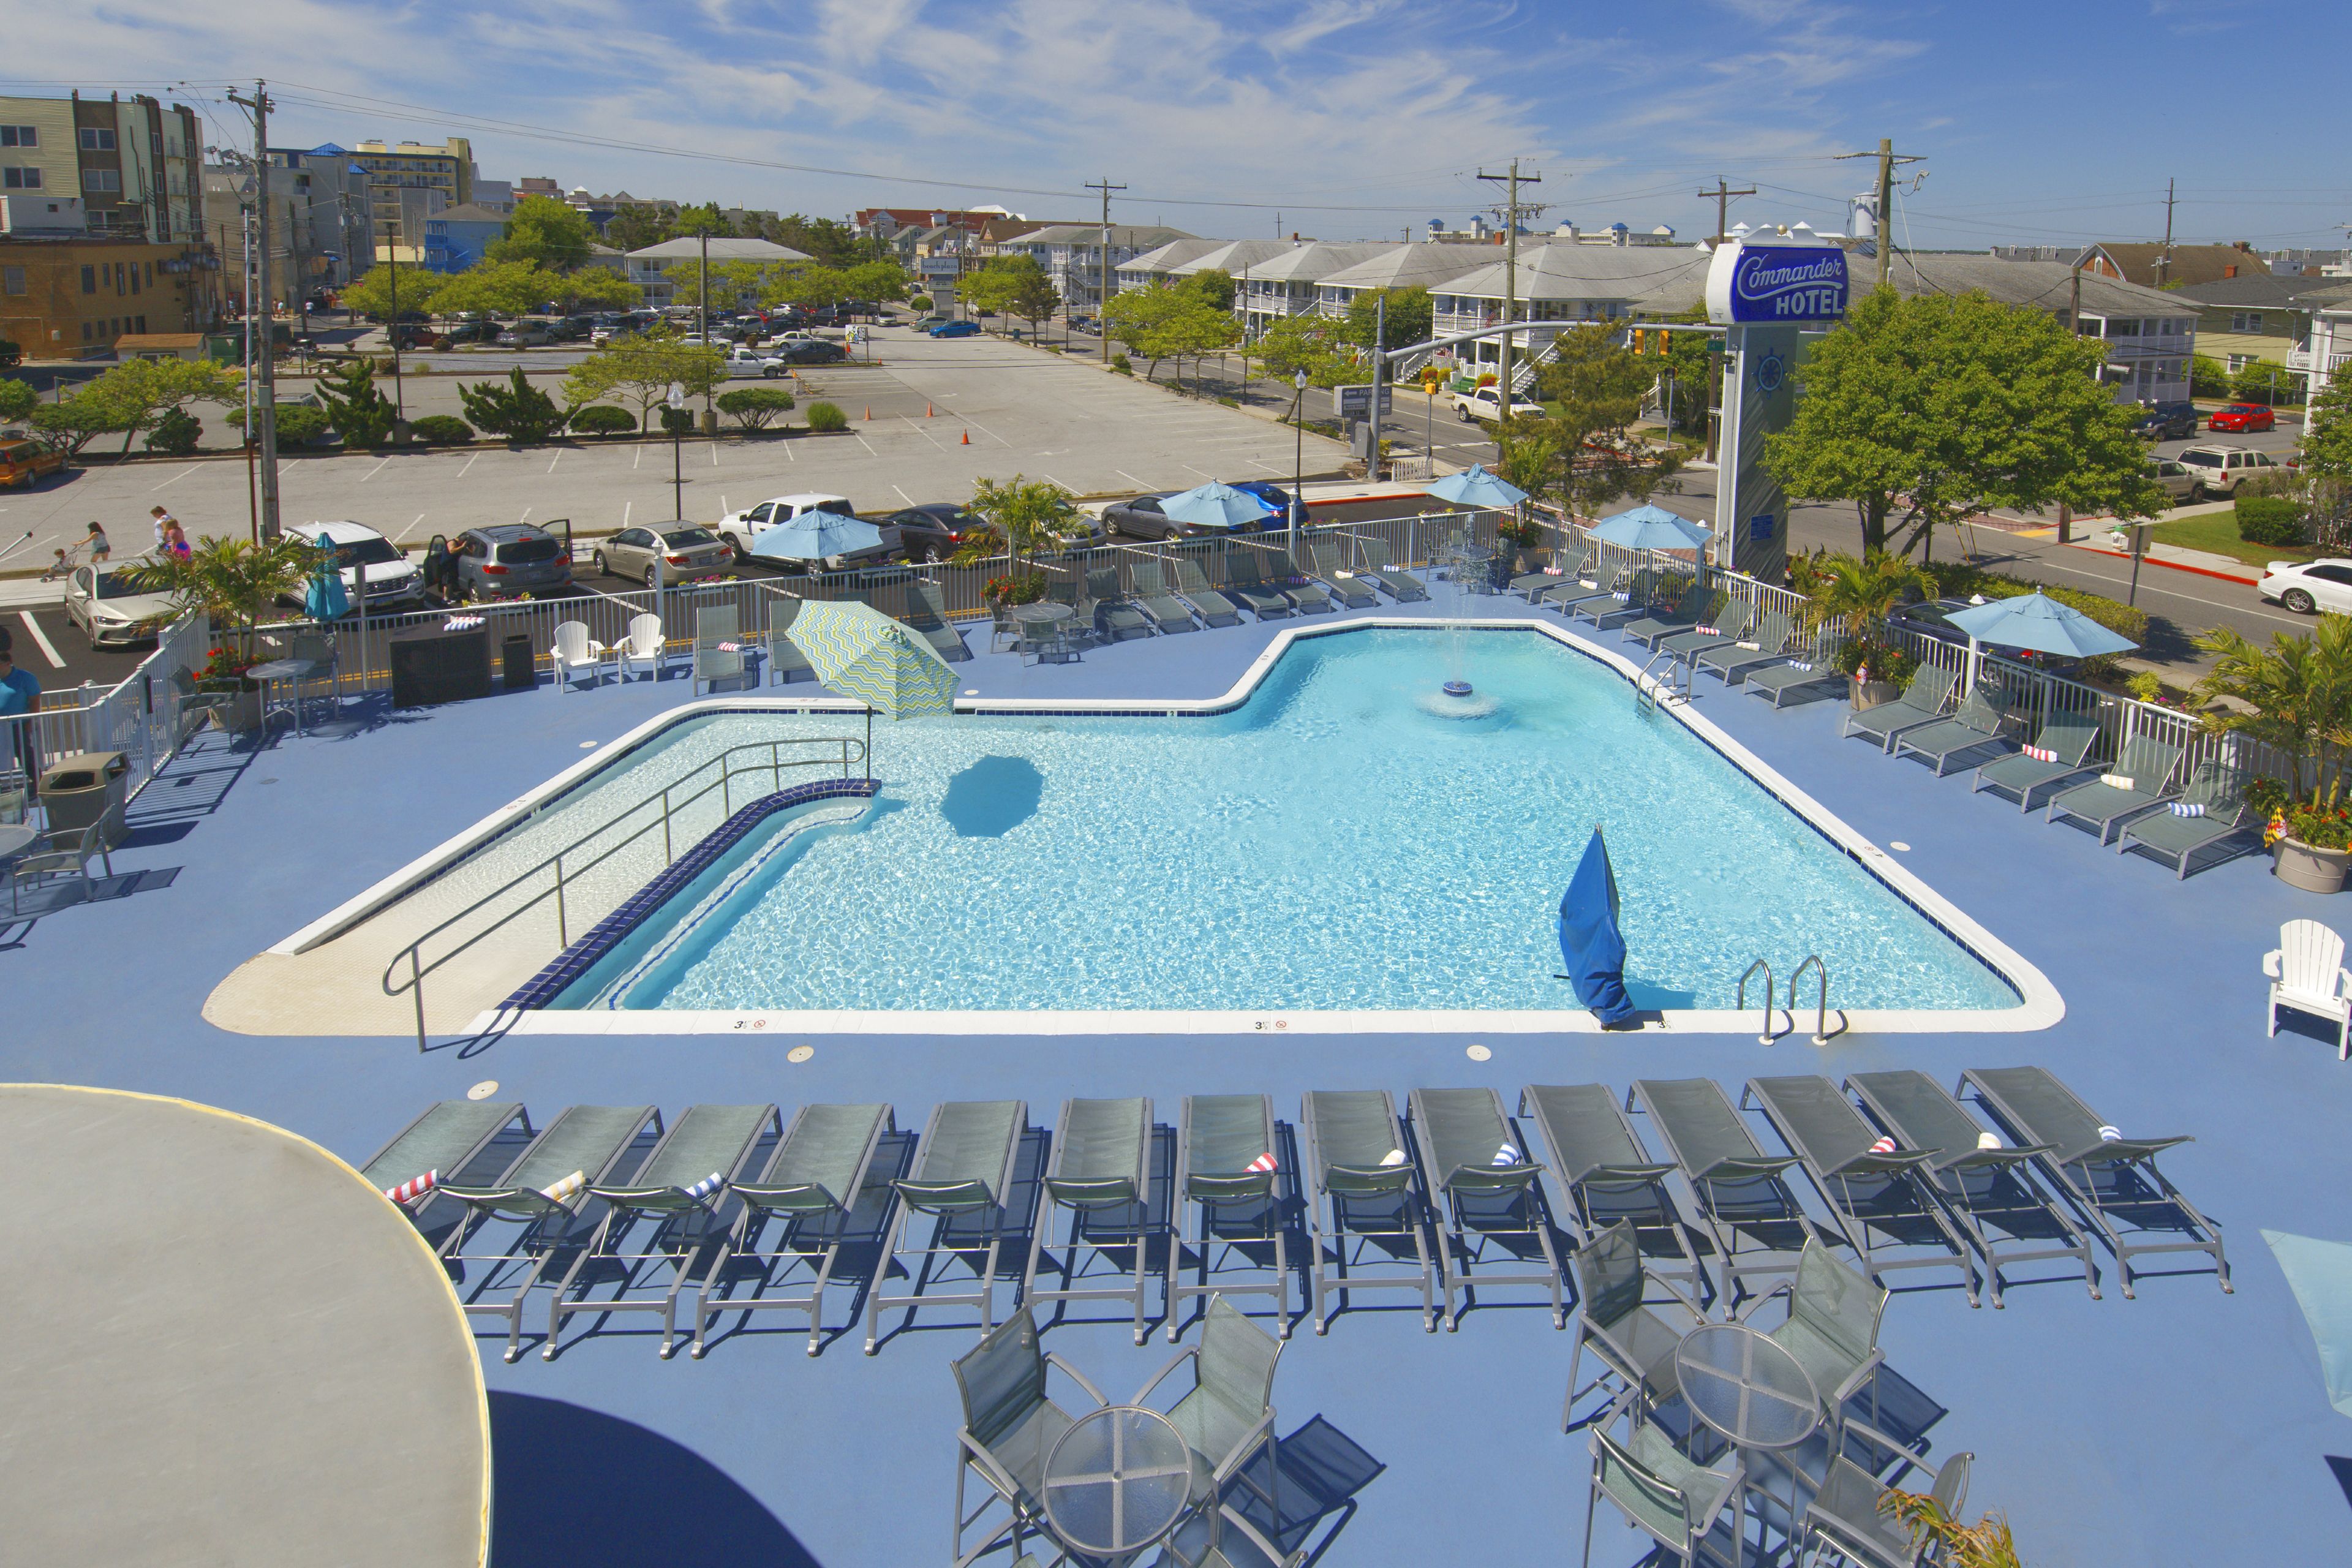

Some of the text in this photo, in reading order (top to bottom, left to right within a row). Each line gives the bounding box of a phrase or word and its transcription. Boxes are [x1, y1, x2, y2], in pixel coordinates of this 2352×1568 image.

[922, 260, 957, 271] beach plaza
[1737, 254, 1843, 300] Commander
[1776, 290, 1843, 315] HOTEL
